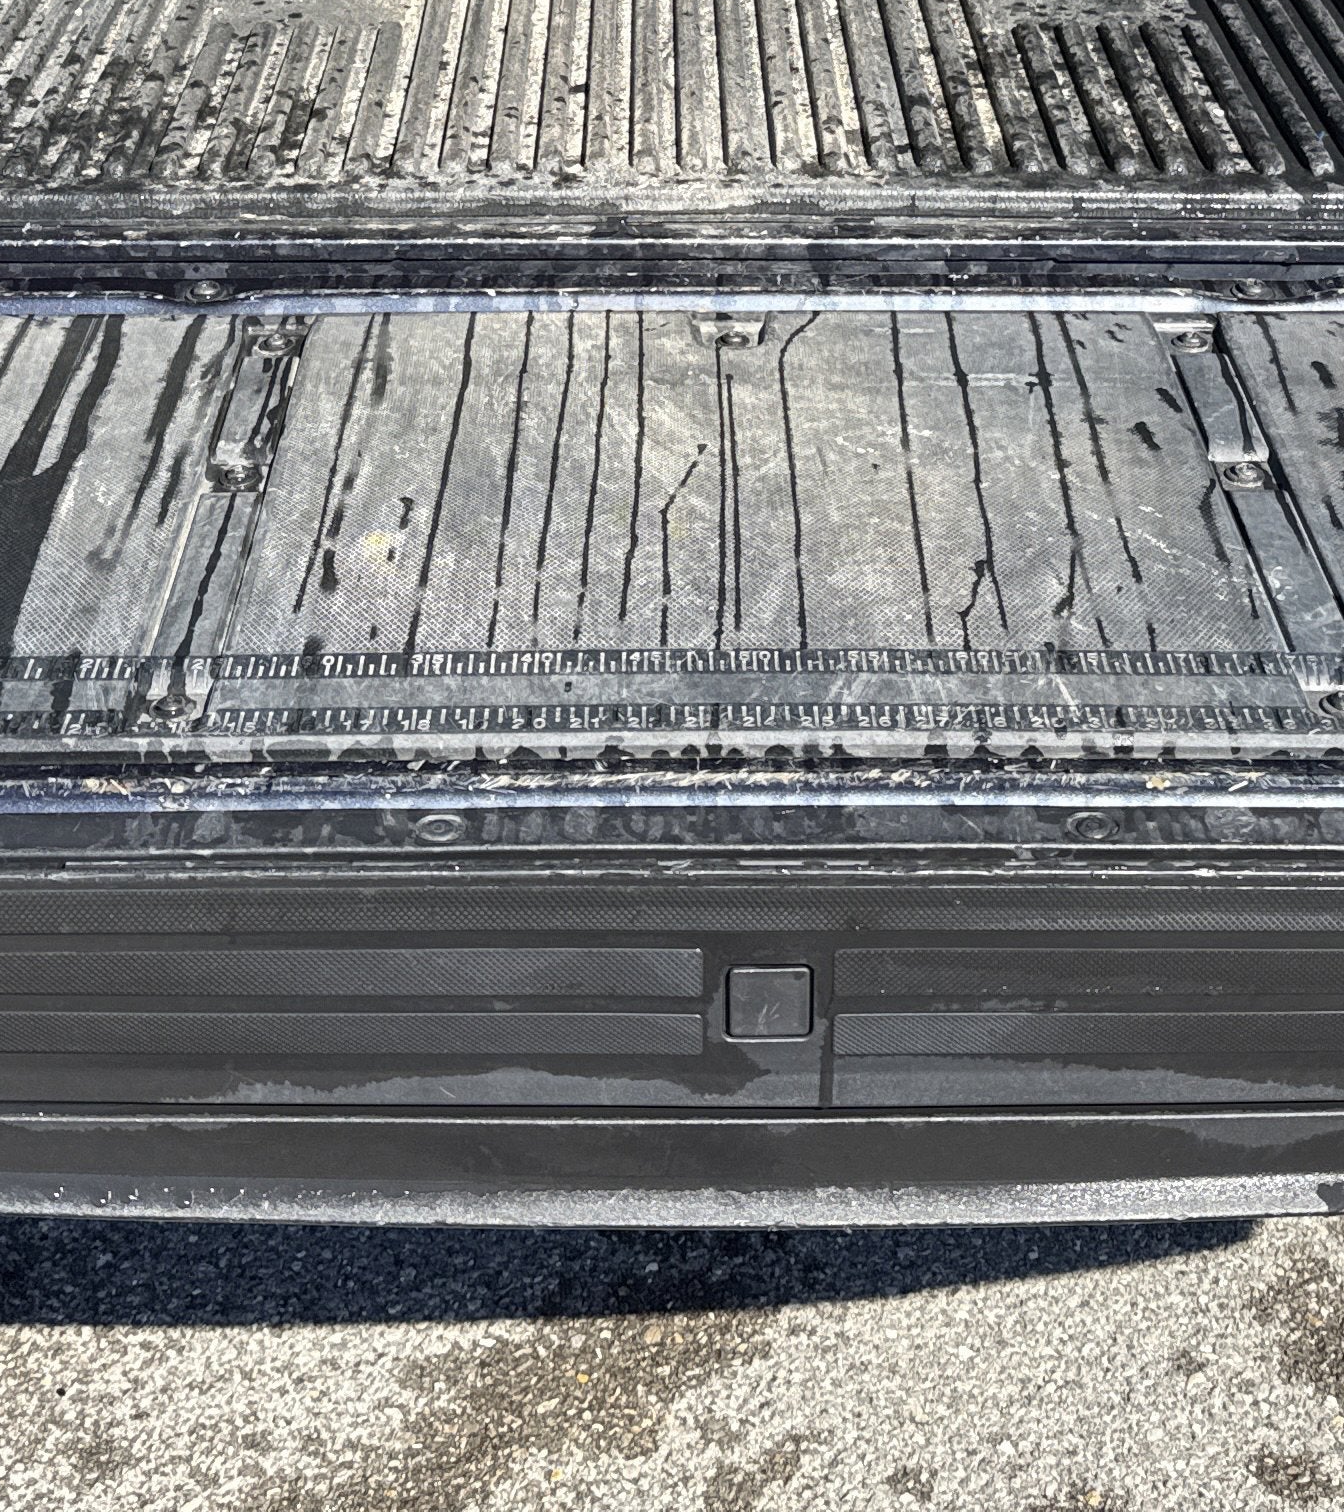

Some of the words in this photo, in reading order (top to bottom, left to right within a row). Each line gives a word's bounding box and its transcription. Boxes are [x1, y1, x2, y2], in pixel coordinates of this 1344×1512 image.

[411, 654, 445, 664] 35
[521, 653, 554, 663] 40
[629, 651, 663, 662] 45
[848, 651, 880, 661] 55
[400, 719, 430, 731] 18
[512, 718, 546, 729] 20
[570, 718, 600, 729] 21
[742, 716, 777, 727] 24
[800, 716, 835, 727] 25
[858, 716, 891, 727] 26
